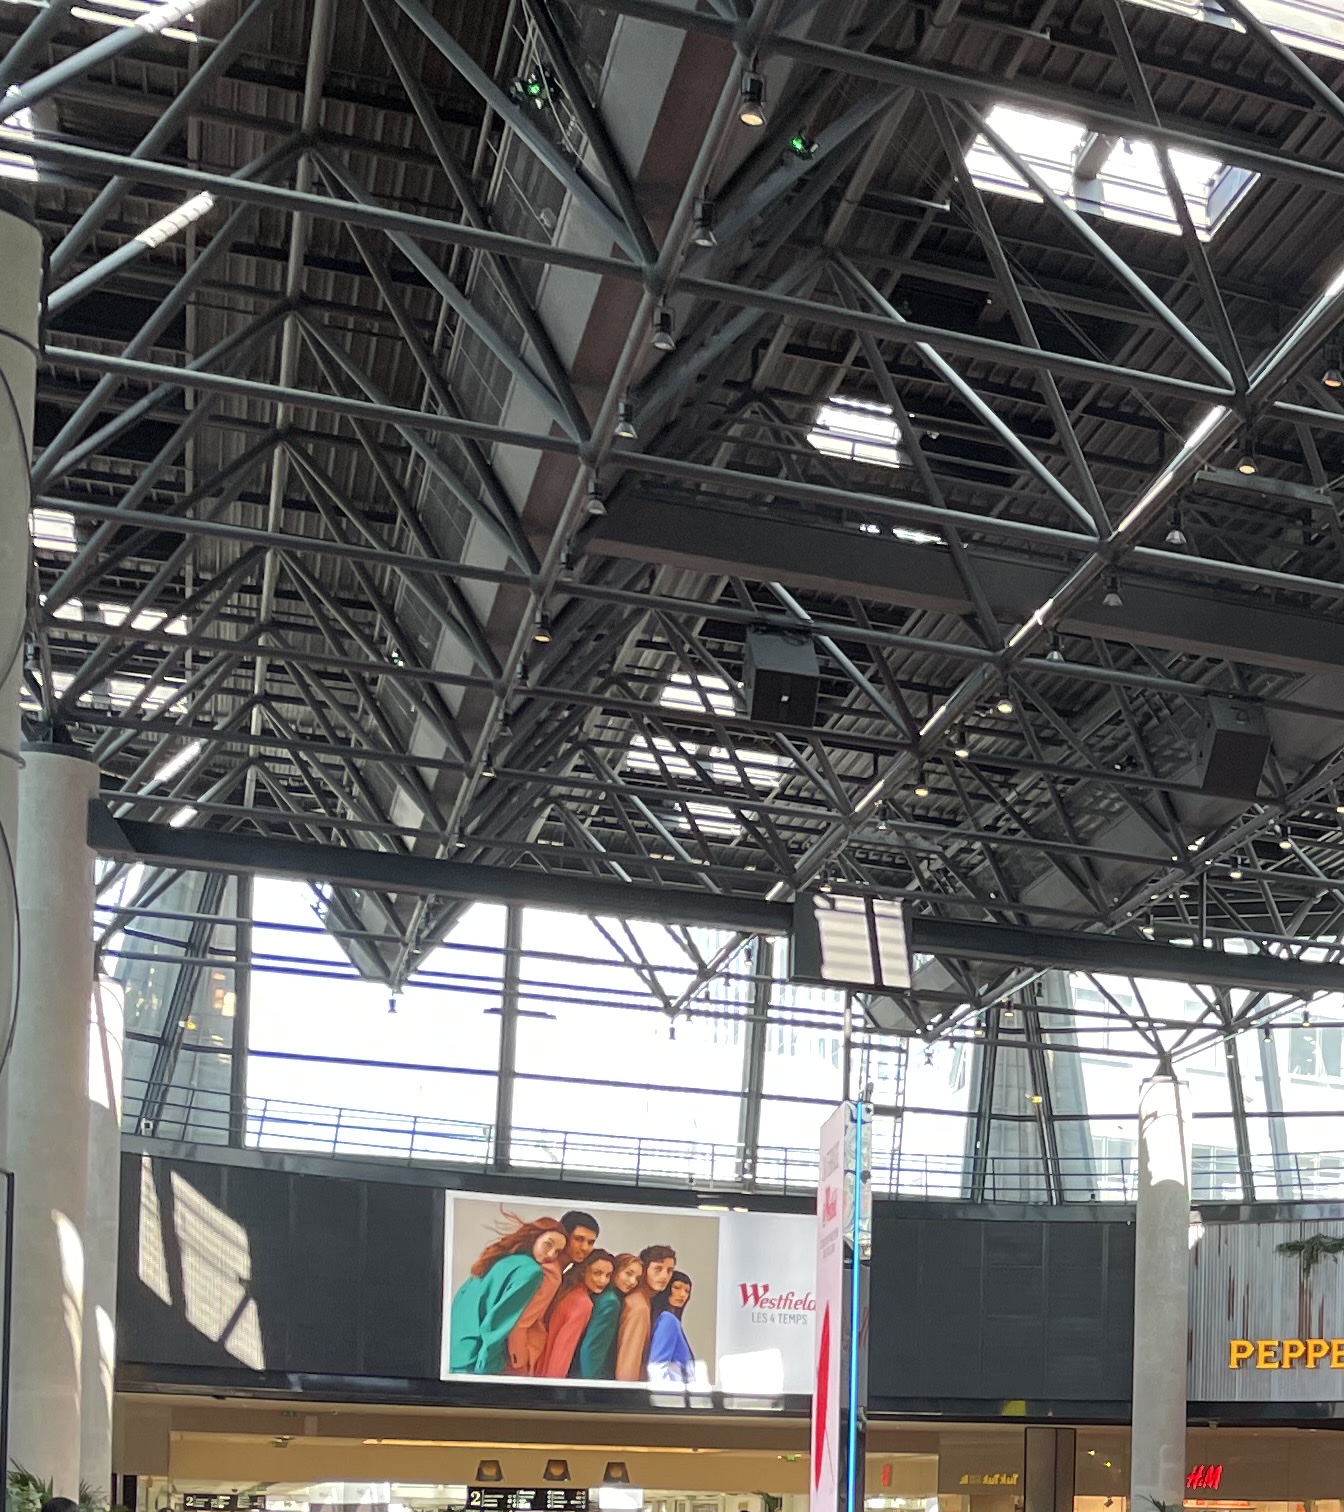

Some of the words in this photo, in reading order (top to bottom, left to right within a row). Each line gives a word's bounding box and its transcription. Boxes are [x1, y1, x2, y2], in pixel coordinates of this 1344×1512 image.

[751, 1312, 768, 1324] LES
[770, 1313, 776, 1324] 4
[778, 1313, 808, 1326] TEMPS
[185, 1496, 194, 1508] 2
[470, 1491, 481, 1507] 2
